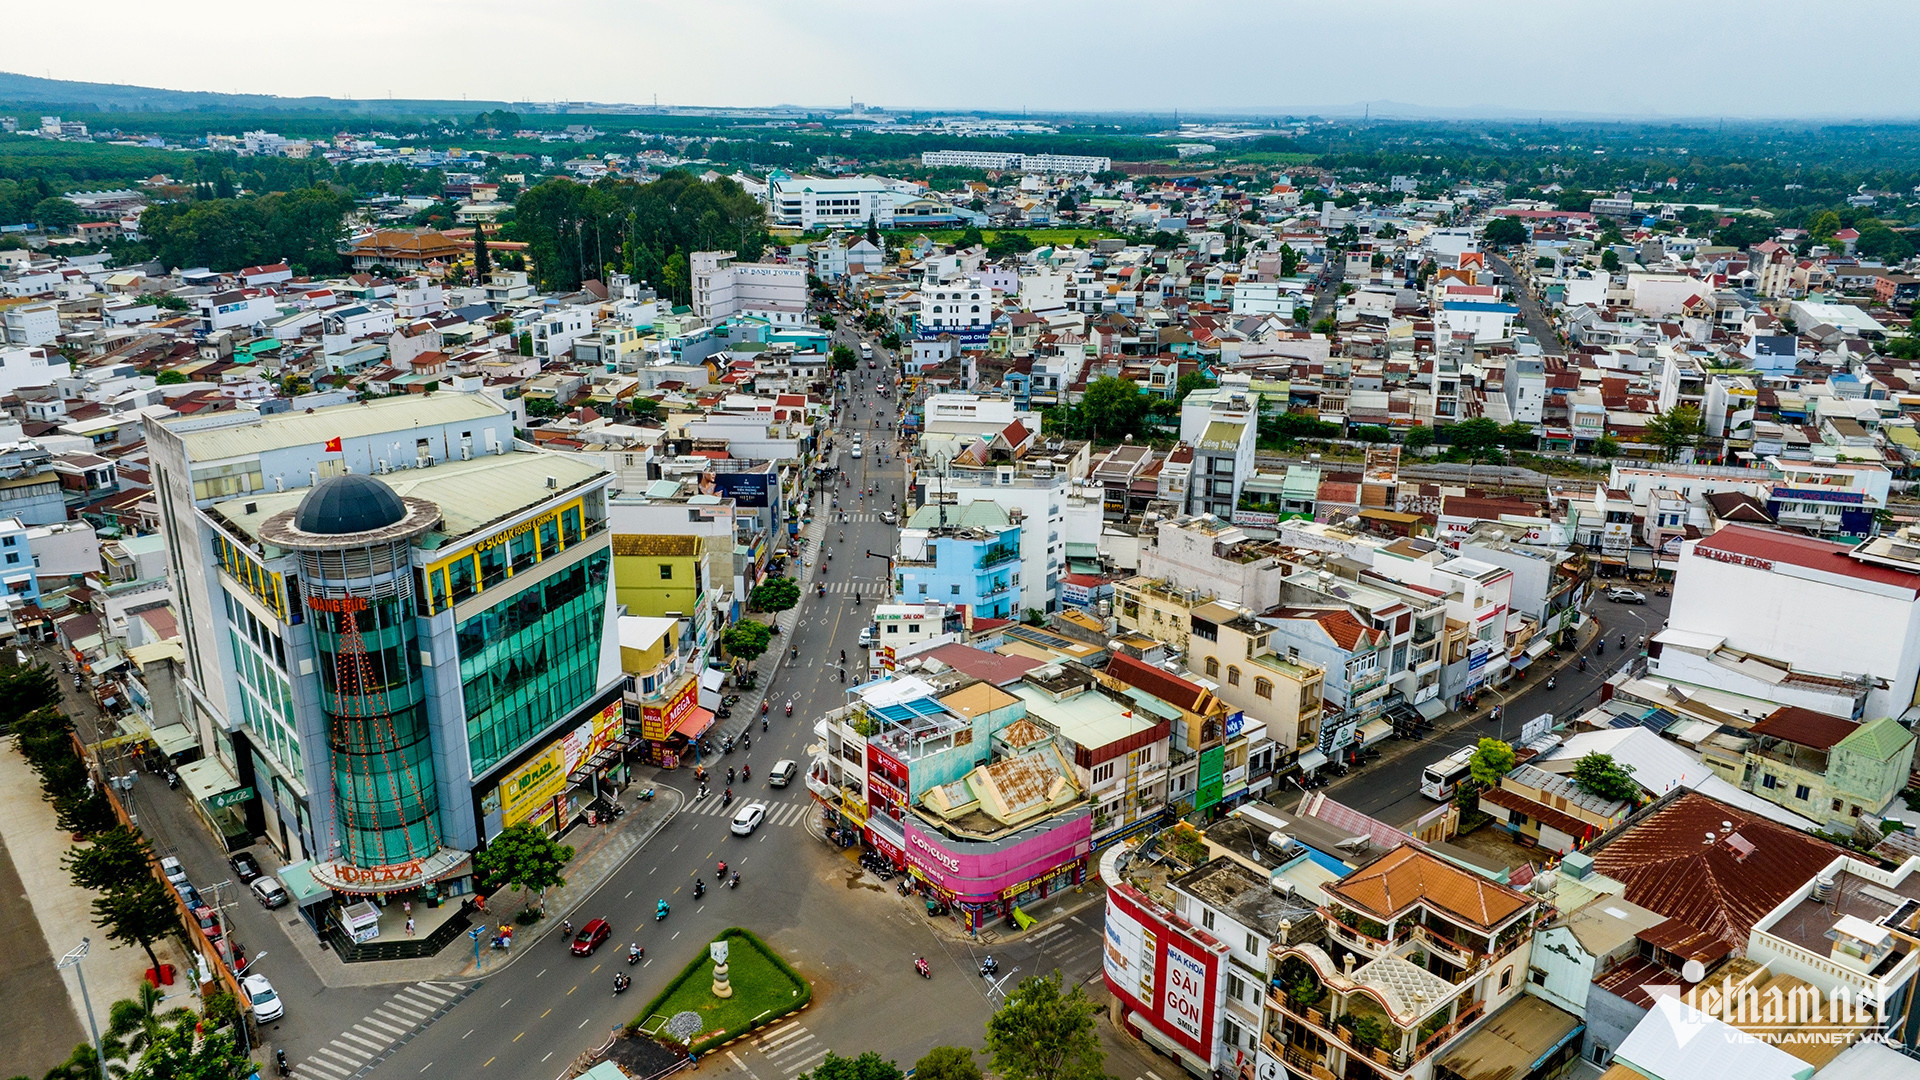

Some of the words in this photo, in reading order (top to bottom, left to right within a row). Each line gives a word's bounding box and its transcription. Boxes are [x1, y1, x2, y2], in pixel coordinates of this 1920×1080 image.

[1774, 489, 1789, 498] GA
[1793, 491, 1821, 500] LONG
[1823, 492, 1861, 503] KHÁNH
[1448, 524, 1468, 532] KIM
[669, 695, 690, 723] MEGA
[519, 773, 531, 790] HD
[532, 761, 552, 781] PLAZA
[333, 864, 359, 883] HD
[361, 863, 423, 883] PLAZA
[1167, 948, 1183, 963] NHA
[1183, 957, 1205, 977] KHOA
[1172, 969, 1198, 998] SÀI
[1167, 991, 1200, 1024] GÒN
[1177, 1017, 1199, 1037] SMILE
